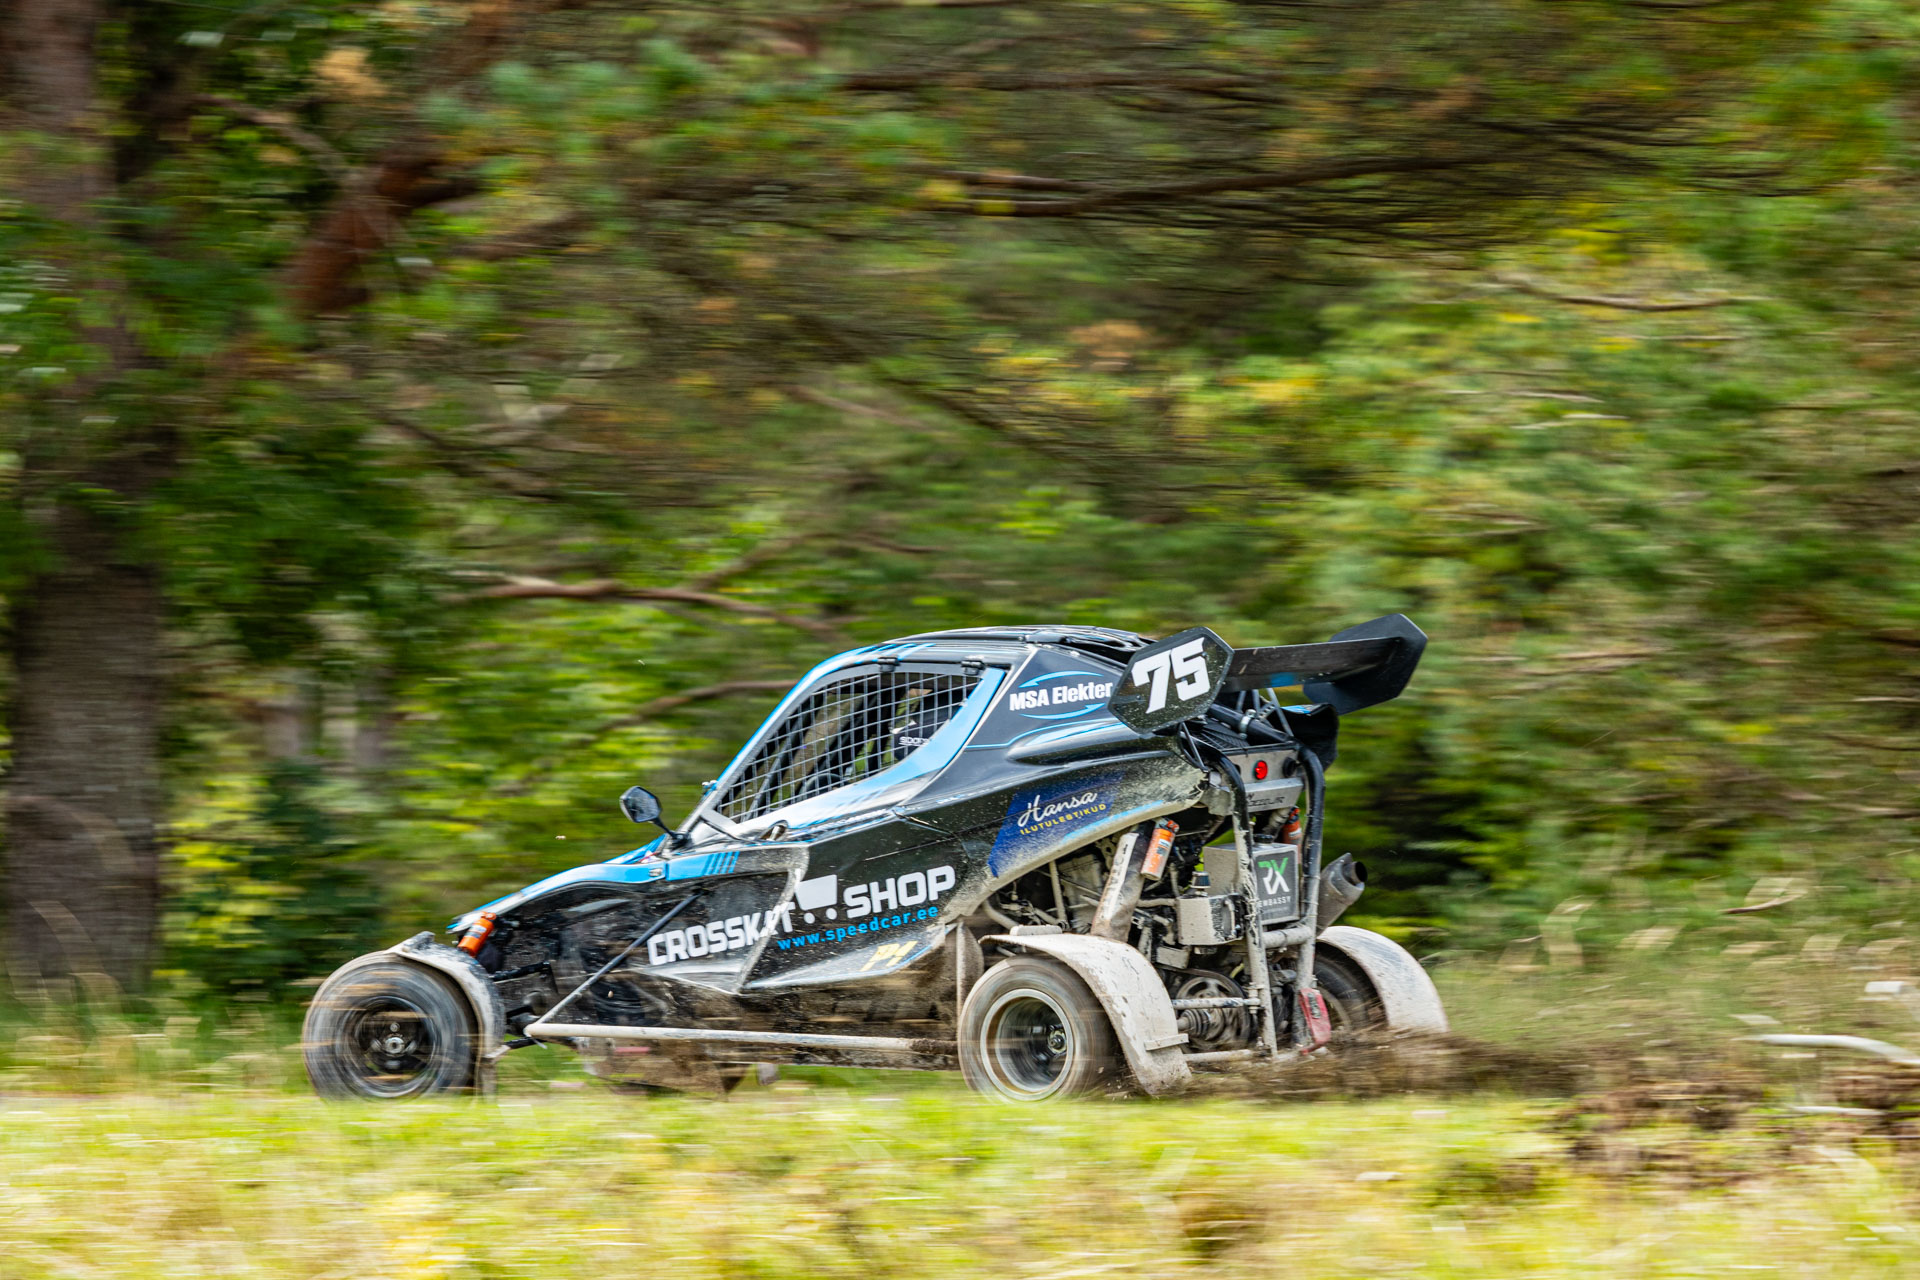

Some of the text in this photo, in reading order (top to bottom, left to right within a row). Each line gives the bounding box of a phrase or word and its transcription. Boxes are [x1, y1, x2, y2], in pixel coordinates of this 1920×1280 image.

[1131, 637, 1211, 714] 75
[1009, 682, 1113, 711] MSA Elekter
[1017, 792, 1098, 827] Hansa
[1020, 804, 1107, 835] ILUTULESTIKUD
[843, 865, 956, 918] SHOP
[777, 906, 939, 950] www.speedcar.ee
